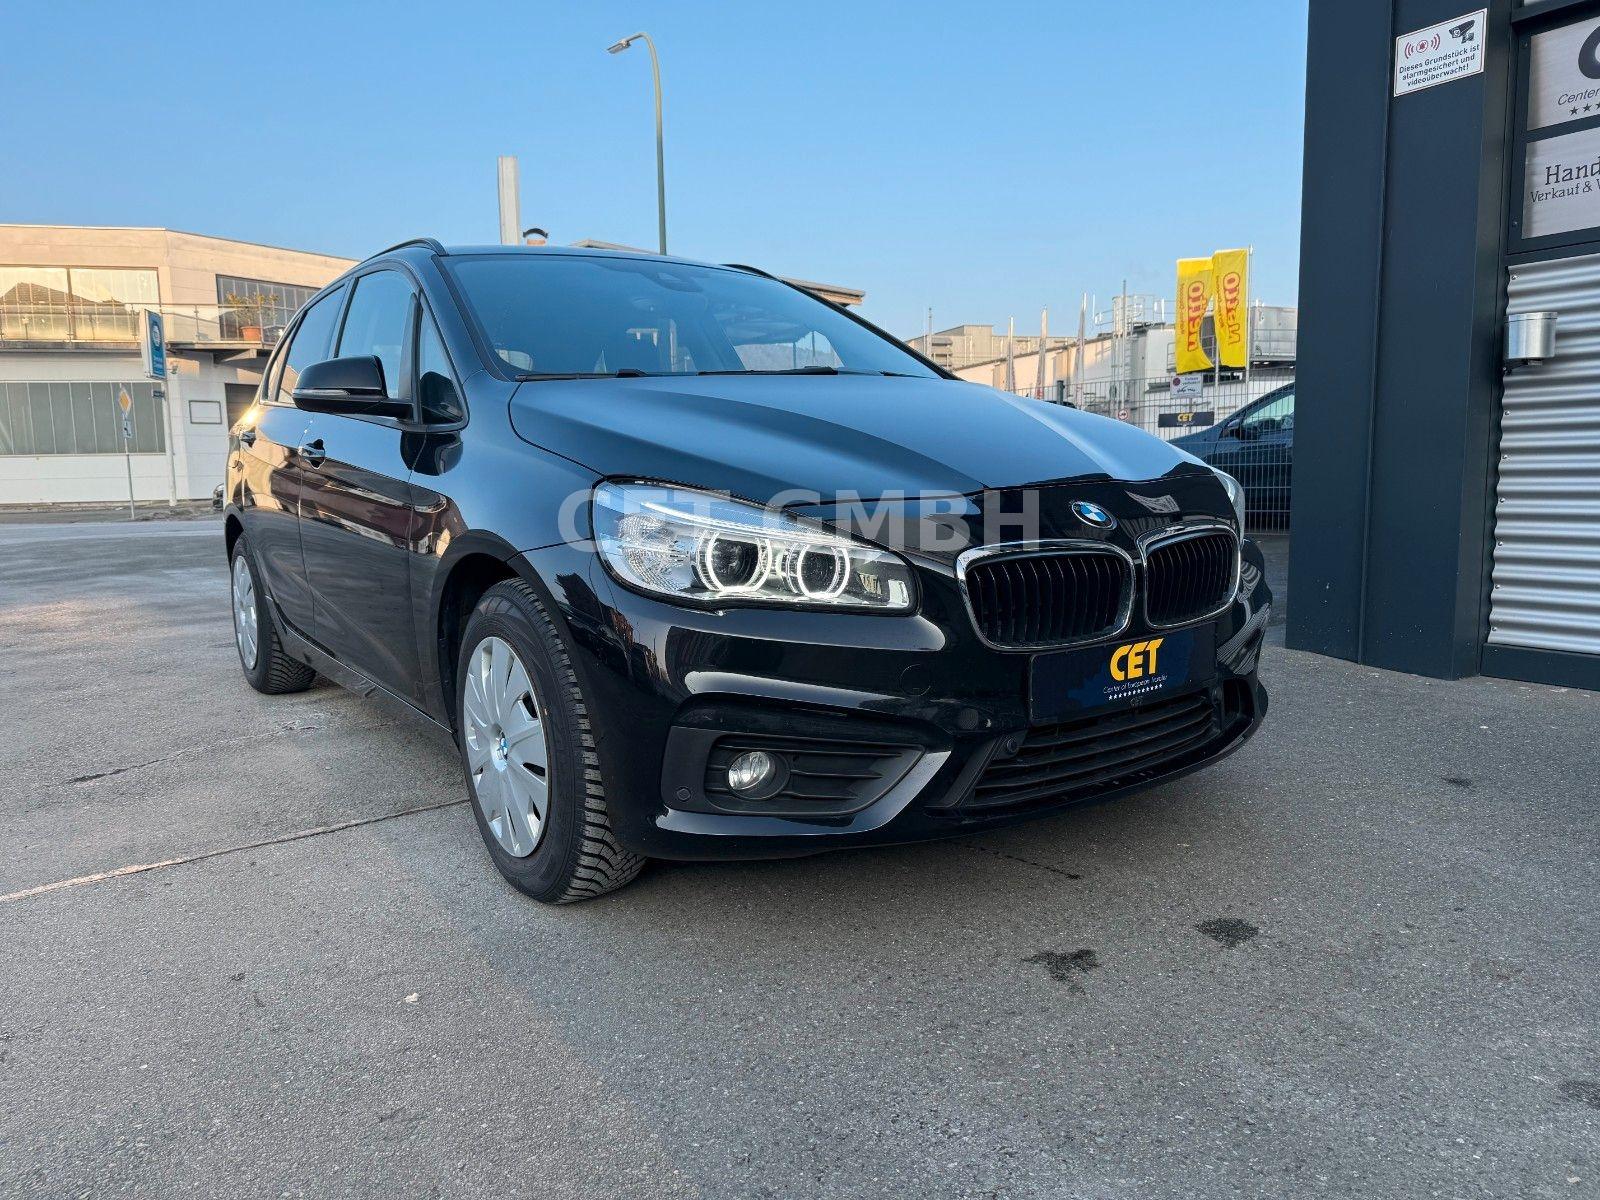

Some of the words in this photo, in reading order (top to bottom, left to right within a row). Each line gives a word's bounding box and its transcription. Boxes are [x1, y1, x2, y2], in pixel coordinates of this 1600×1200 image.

[1399, 62, 1423, 74] Dieses
[1424, 47, 1468, 66] Grundstück
[1469, 44, 1480, 53] ist
[1402, 58, 1459, 81] alarmgesichert
[1460, 53, 1475, 63] und
[1407, 63, 1469, 86] videoüberwacht!
[1557, 87, 1600, 106] Center
[1530, 182, 1580, 203] Verkauf
[1582, 180, 1593, 193] &
[1110, 637, 1165, 681] CET
